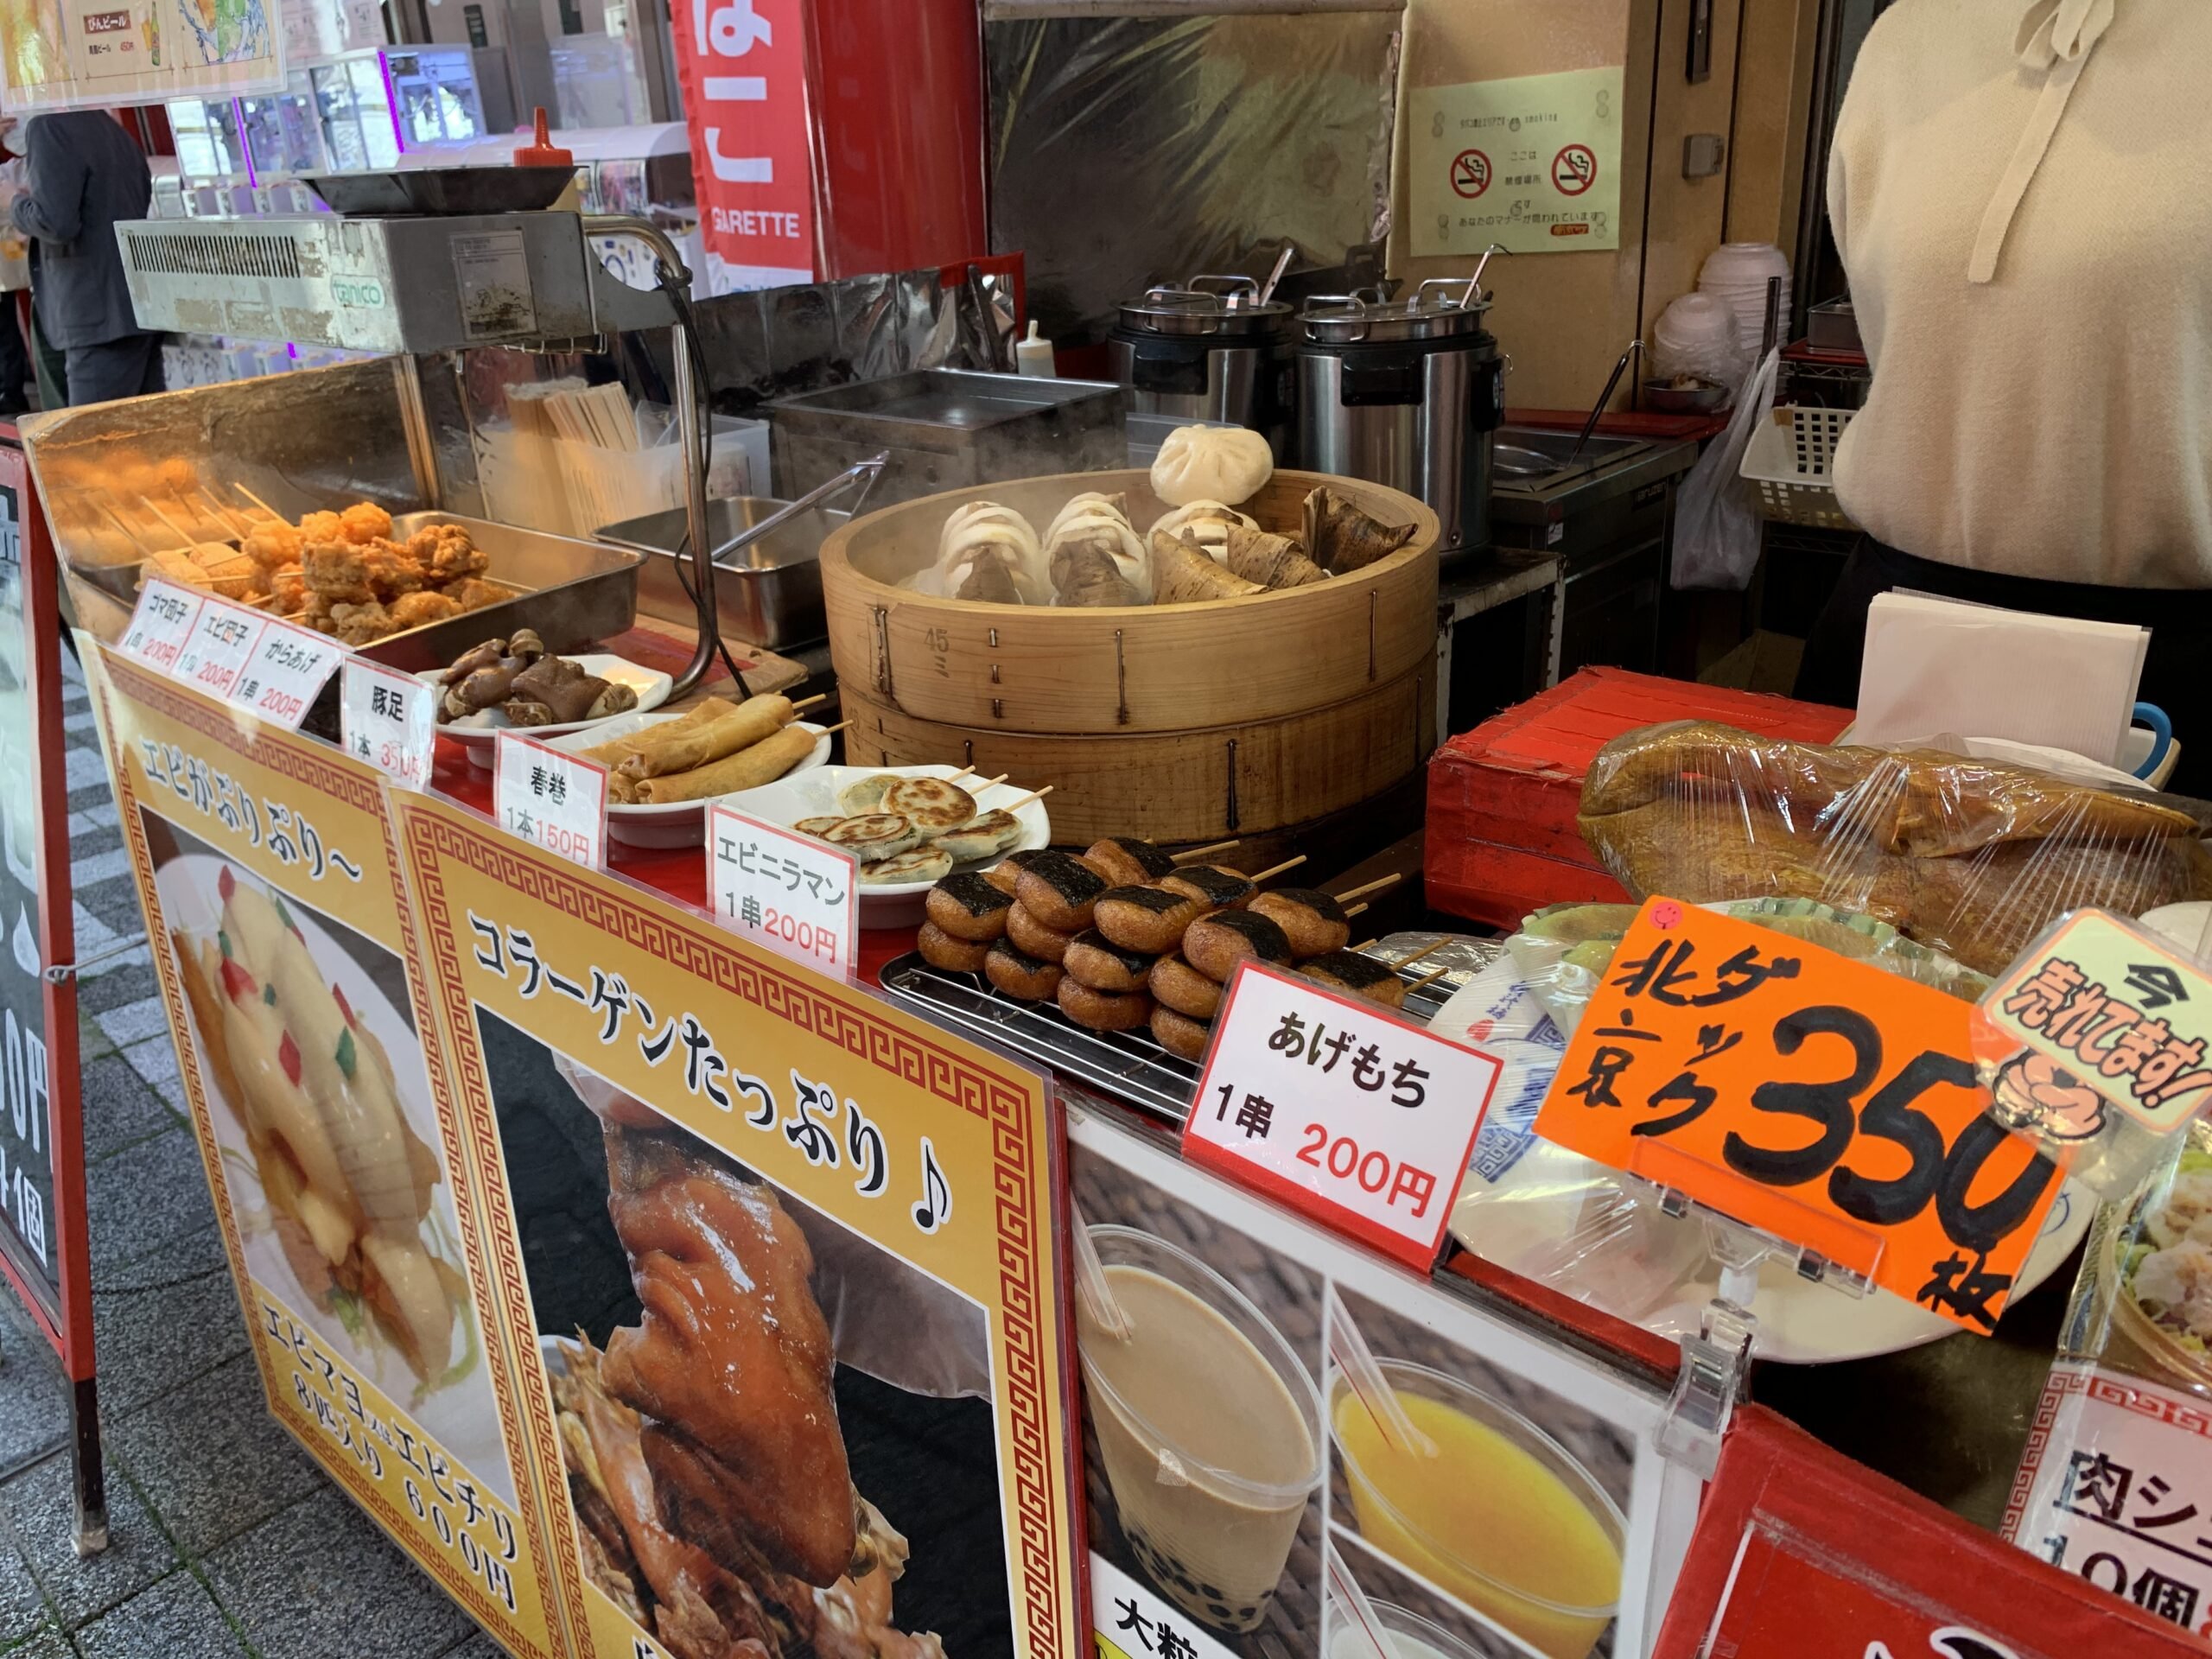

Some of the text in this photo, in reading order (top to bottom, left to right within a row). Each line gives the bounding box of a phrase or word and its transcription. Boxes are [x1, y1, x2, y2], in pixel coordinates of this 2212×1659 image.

[87, 15, 127, 31] びんビール
[1510, 150, 1537, 161] ここは
[1504, 175, 1541, 186] 禁煙場所
[149, 593, 189, 625] ゴマ団子
[203, 615, 249, 647] エビ団子
[143, 639, 177, 666] 200円
[264, 639, 322, 674] からあげ
[198, 660, 236, 690] 200円
[238, 677, 303, 721] 1串 200円
[372, 685, 404, 722] 豚足
[349, 730, 371, 760] 1本
[530, 766, 568, 807] 春巻
[716, 836, 846, 907] エビニラマン
[2123, 963, 2191, 1010] 今
[1564, 938, 1696, 1109] 北京
[1268, 1011, 1431, 1109] あげもち
[0, 1007, 54, 1173] 0円
[1722, 1004, 2058, 1255] 350
[1216, 1083, 1437, 1219] 1串 200円
[2058, 1449, 2212, 1552] 肉シ
[404, 1478, 518, 1612] 600円
